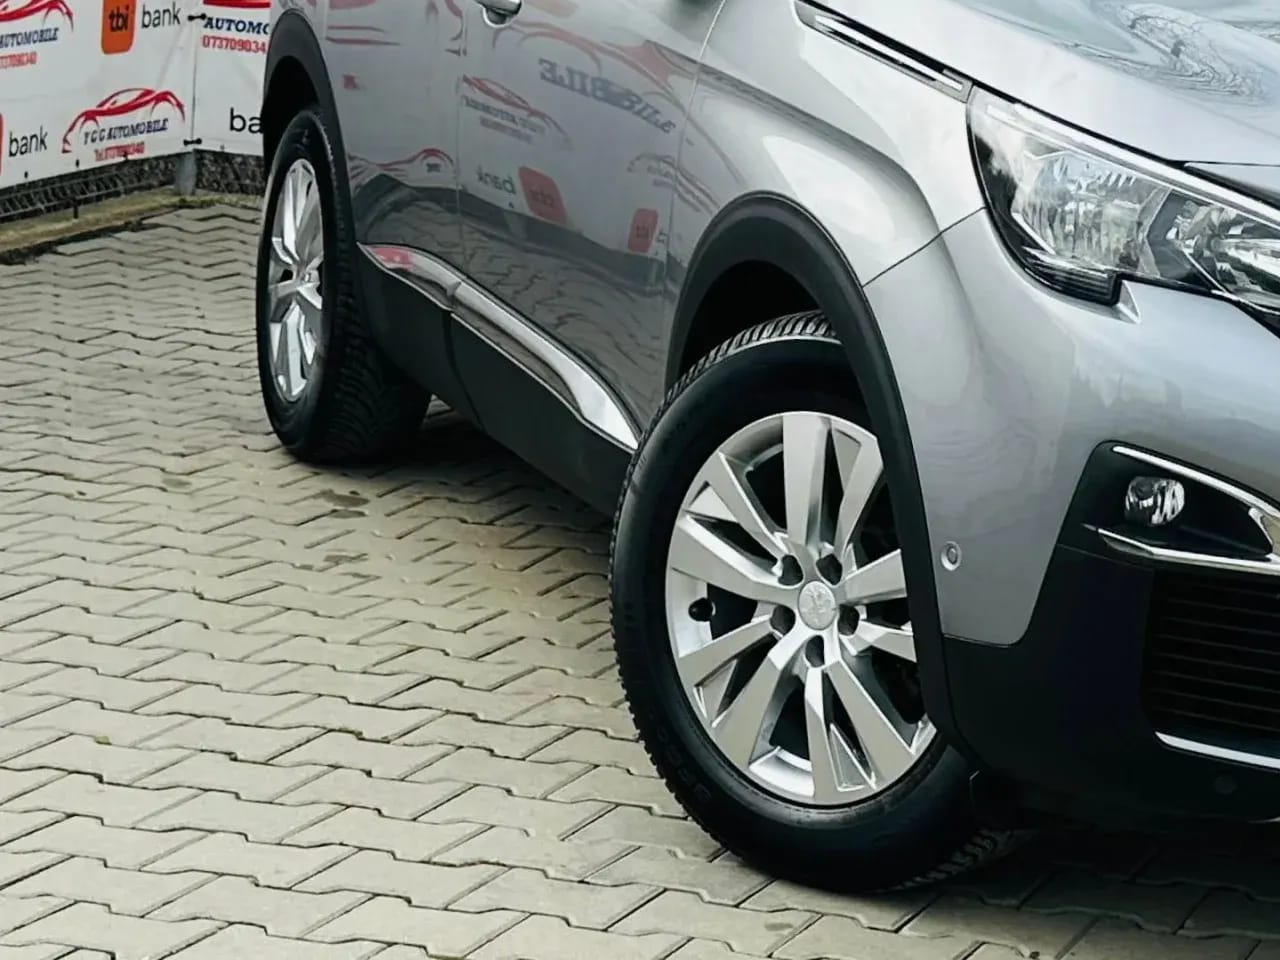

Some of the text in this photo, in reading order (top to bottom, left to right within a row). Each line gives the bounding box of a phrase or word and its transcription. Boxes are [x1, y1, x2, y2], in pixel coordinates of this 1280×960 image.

[109, 4, 129, 33] tbi
[141, 1, 182, 29] bank
[8, 125, 49, 157] bank
[107, 118, 169, 140] AUTOMOBILE
